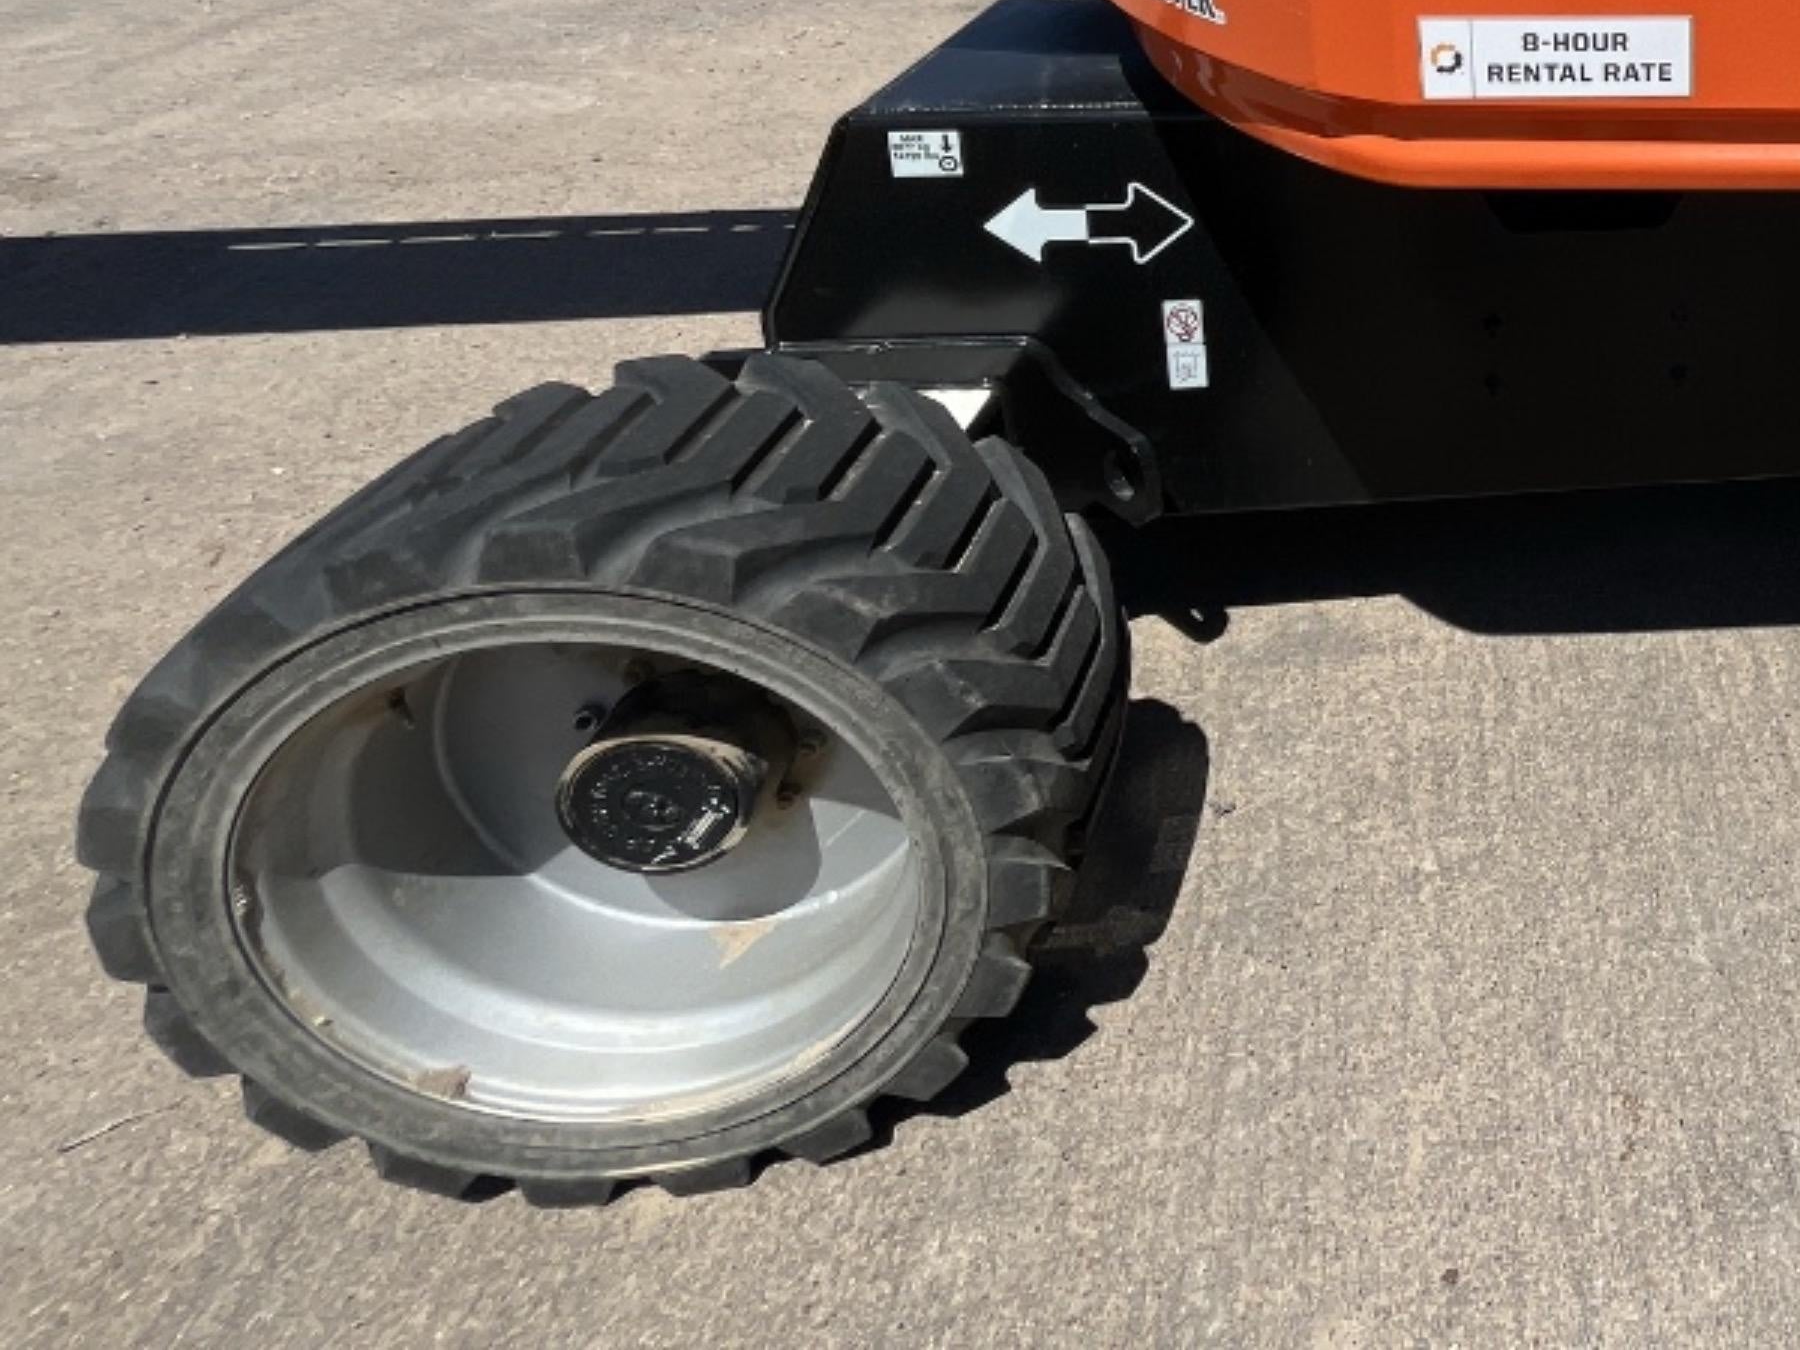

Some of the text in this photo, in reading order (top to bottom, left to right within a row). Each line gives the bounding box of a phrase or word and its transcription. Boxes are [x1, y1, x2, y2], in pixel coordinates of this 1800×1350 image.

[1522, 32, 1629, 52] 8-HOUR
[1487, 62, 1673, 82] RENTAL RATE
